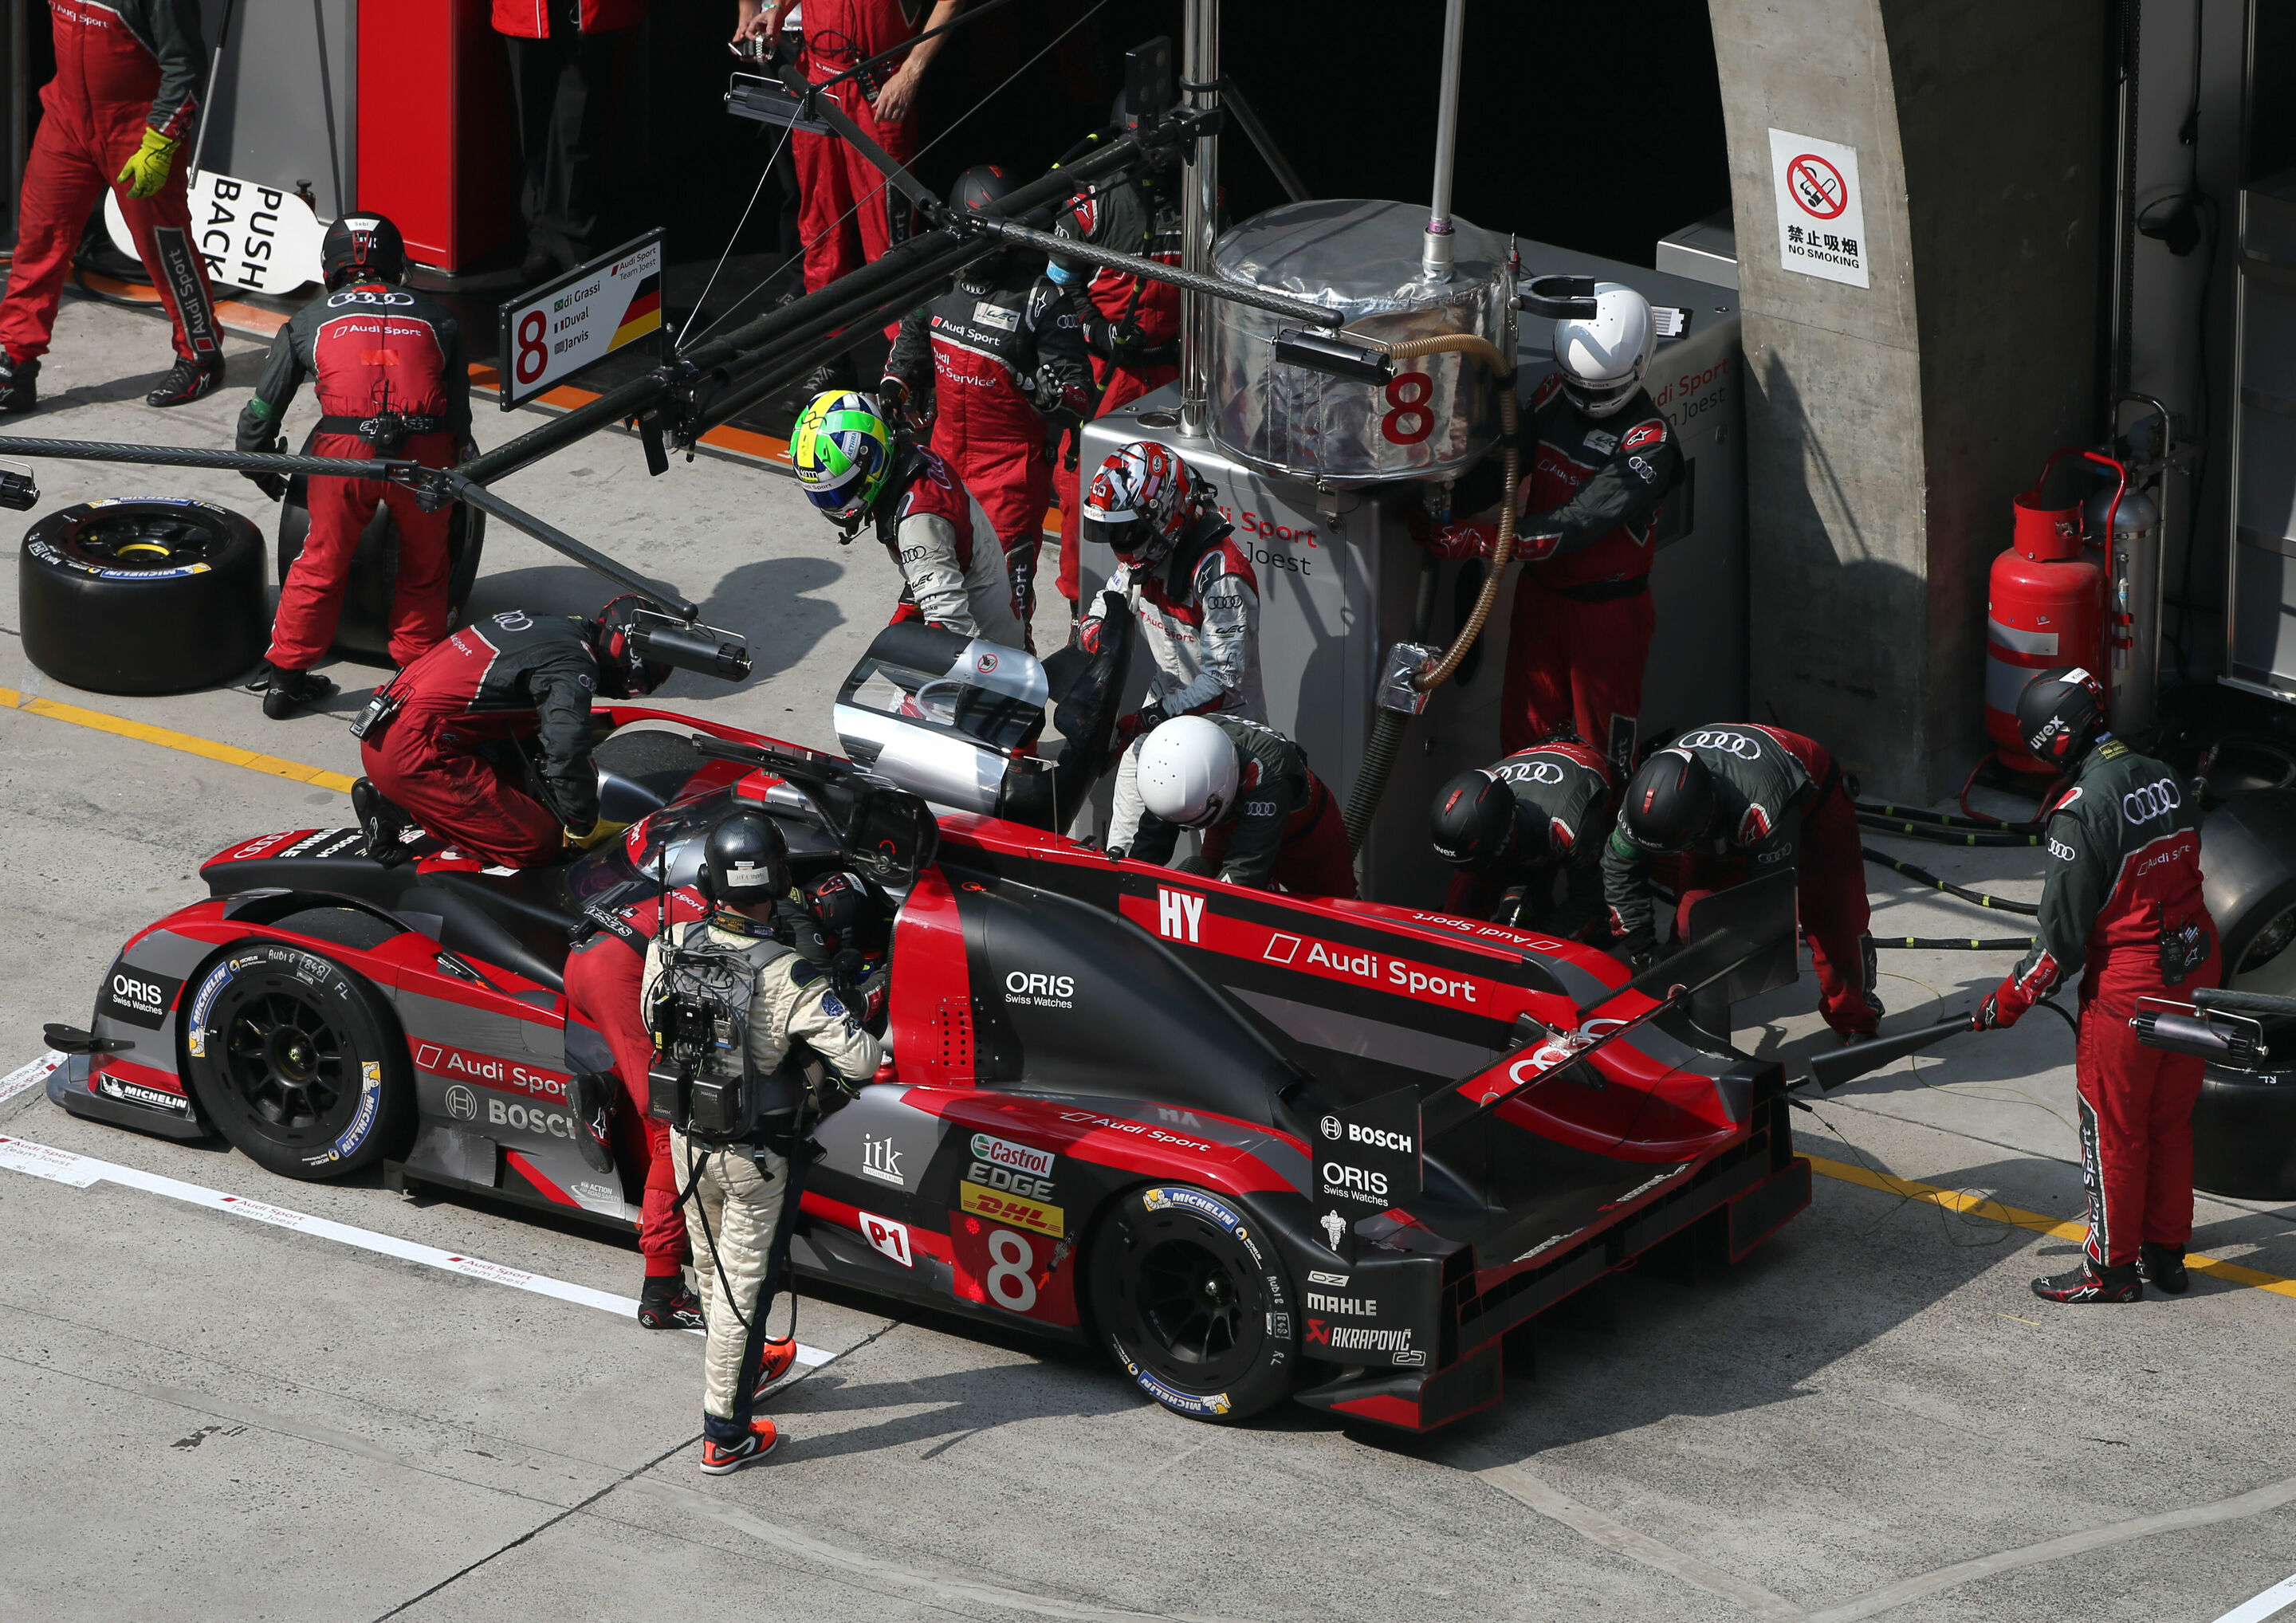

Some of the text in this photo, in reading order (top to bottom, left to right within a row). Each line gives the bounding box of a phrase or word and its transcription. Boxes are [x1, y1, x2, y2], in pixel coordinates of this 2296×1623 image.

[79, 14, 108, 29] Sport
[202, 179, 242, 278] BACK
[238, 187, 283, 289] PUSH
[897, 210, 906, 242] ort
[1787, 225, 1858, 257] 禁止吸烟
[619, 247, 656, 270] Audi Sport
[619, 258, 656, 281] Team Joest
[1789, 245, 1859, 269] NO SMOKING
[168, 248, 206, 333] Audi Sport
[564, 281, 600, 308] di Grassi
[564, 306, 589, 328] Duval
[986, 310, 1017, 322] WEC
[349, 324, 422, 336] Audi Sport
[564, 330, 589, 352] Jarvis
[942, 320, 1001, 346] Audi Sport
[517, 310, 548, 384] 8
[946, 367, 993, 387] Service
[1678, 359, 1729, 397] Sport
[1382, 372, 1434, 445] 8
[1682, 387, 1726, 425] Joest
[847, 431, 858, 458] AETHRA
[813, 483, 833, 495] Sport
[1241, 512, 1317, 548] Sport
[1246, 541, 1311, 576] Joest
[104, 569, 177, 580] MICHELIN
[912, 572, 934, 590] WEC
[1165, 627, 1195, 643] Sport
[1216, 624, 1246, 635] WEC
[2031, 715, 2065, 750] uvex
[1618, 737, 1628, 767] ort
[316, 835, 363, 858] BOSCH
[1433, 843, 1457, 858] uvex
[2149, 852, 2169, 869] Audi
[678, 894, 705, 912] Sport
[1158, 889, 1205, 944] HY
[1412, 912, 1530, 943] Audi Sport
[269, 949, 296, 963] AUDI 8
[304, 959, 325, 976] 848
[1005, 971, 1075, 997] ORIS
[1306, 943, 1476, 1003] Audi Sport
[113, 974, 162, 1004] ORIS
[193, 967, 226, 1025] MICHELIN
[334, 981, 351, 1000] FL
[1005, 993, 1072, 1008] Swiss Watches
[112, 994, 163, 1015] Swiss Watches
[447, 1052, 503, 1081] Audi
[0, 1083, 25, 1098] Spor
[124, 1085, 187, 1109] MICHELIN
[341, 1094, 375, 1153] MICHELIN
[1091, 1118, 1211, 1152] Audi Sport
[1349, 1123, 1412, 1153] BOSCH
[2, 1146, 73, 1167] Team Joest
[10, 1141, 81, 1161] Audi Sport
[863, 1133, 903, 1177] itk
[990, 1142, 1048, 1173] Castrol
[864, 1168, 902, 1184] ENGINEERING
[967, 1161, 1056, 1202] EDGE
[1323, 1162, 1388, 1195] ORIS
[2082, 1126, 2100, 1238] Audi Sport
[590, 1184, 613, 1194] ACTION
[1323, 1184, 1389, 1207] Swiss Watches
[230, 1204, 298, 1227] Team Joest
[239, 1200, 305, 1221] Audi Sport
[976, 1194, 1048, 1228] DHL
[1173, 1192, 1235, 1226] MICHELIN
[867, 1220, 906, 1260] P1
[1245, 1237, 1262, 1259] MICHELIN
[457, 1264, 527, 1287] Team Joest
[466, 1259, 534, 1281] Audi Sport
[987, 1229, 1036, 1311] 8
[1267, 1275, 1281, 1303] AUDI
[1307, 1292, 1377, 1315] MAHLE
[1331, 1326, 1412, 1351] AKRAPOVIČ
[1396, 1350, 1422, 1363] 25
[1140, 1377, 1201, 1412] MICHELIN
